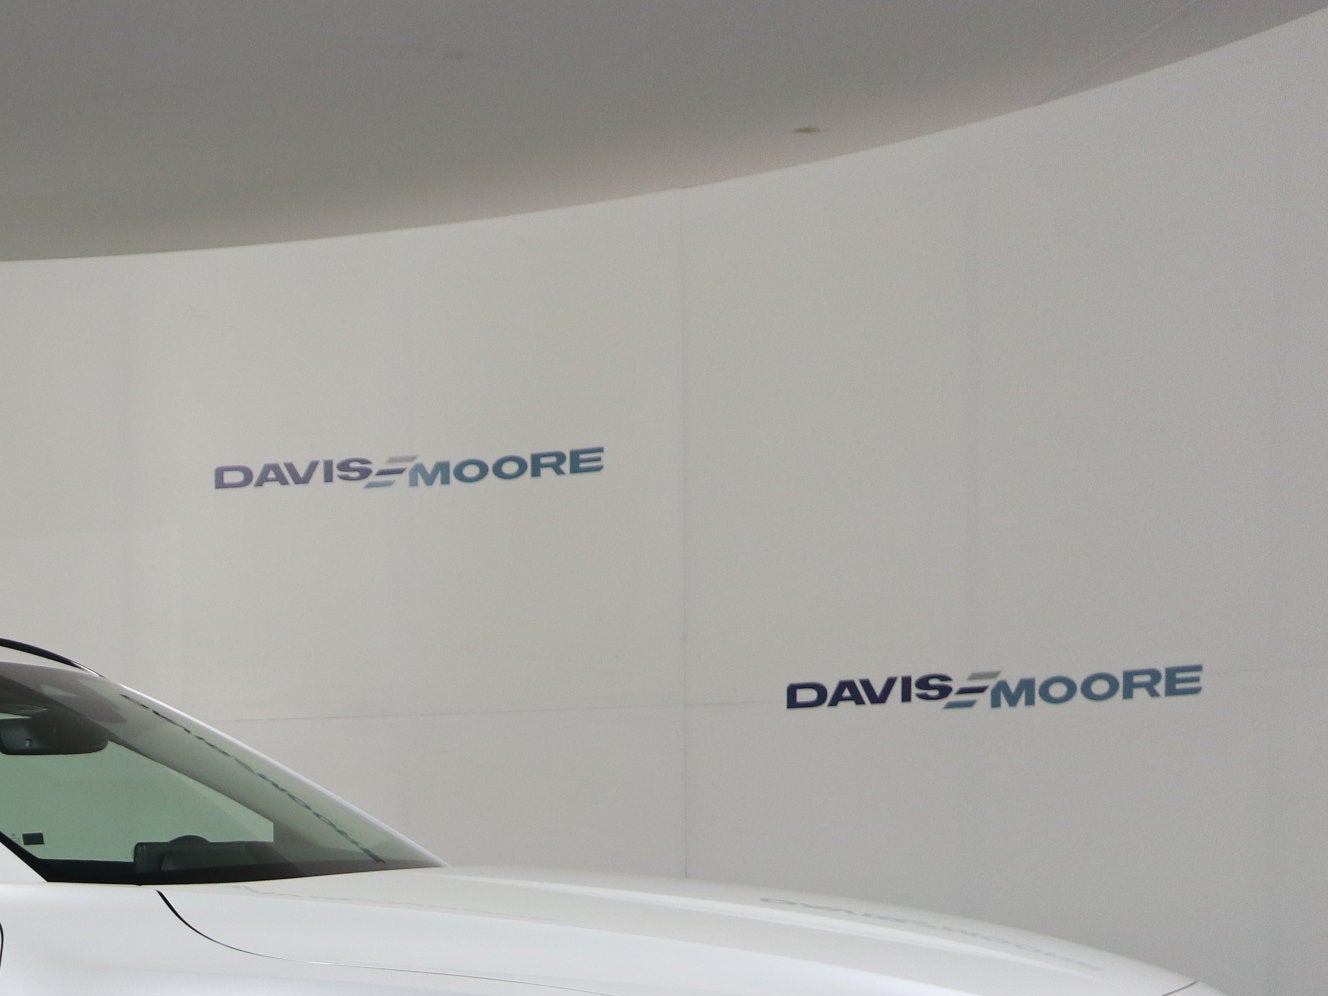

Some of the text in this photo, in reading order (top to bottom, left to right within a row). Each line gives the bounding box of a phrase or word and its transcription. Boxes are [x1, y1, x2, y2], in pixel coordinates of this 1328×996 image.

[214, 446, 605, 490] DAVIS MOORE
[786, 664, 1204, 710] DAVIS MOORE
